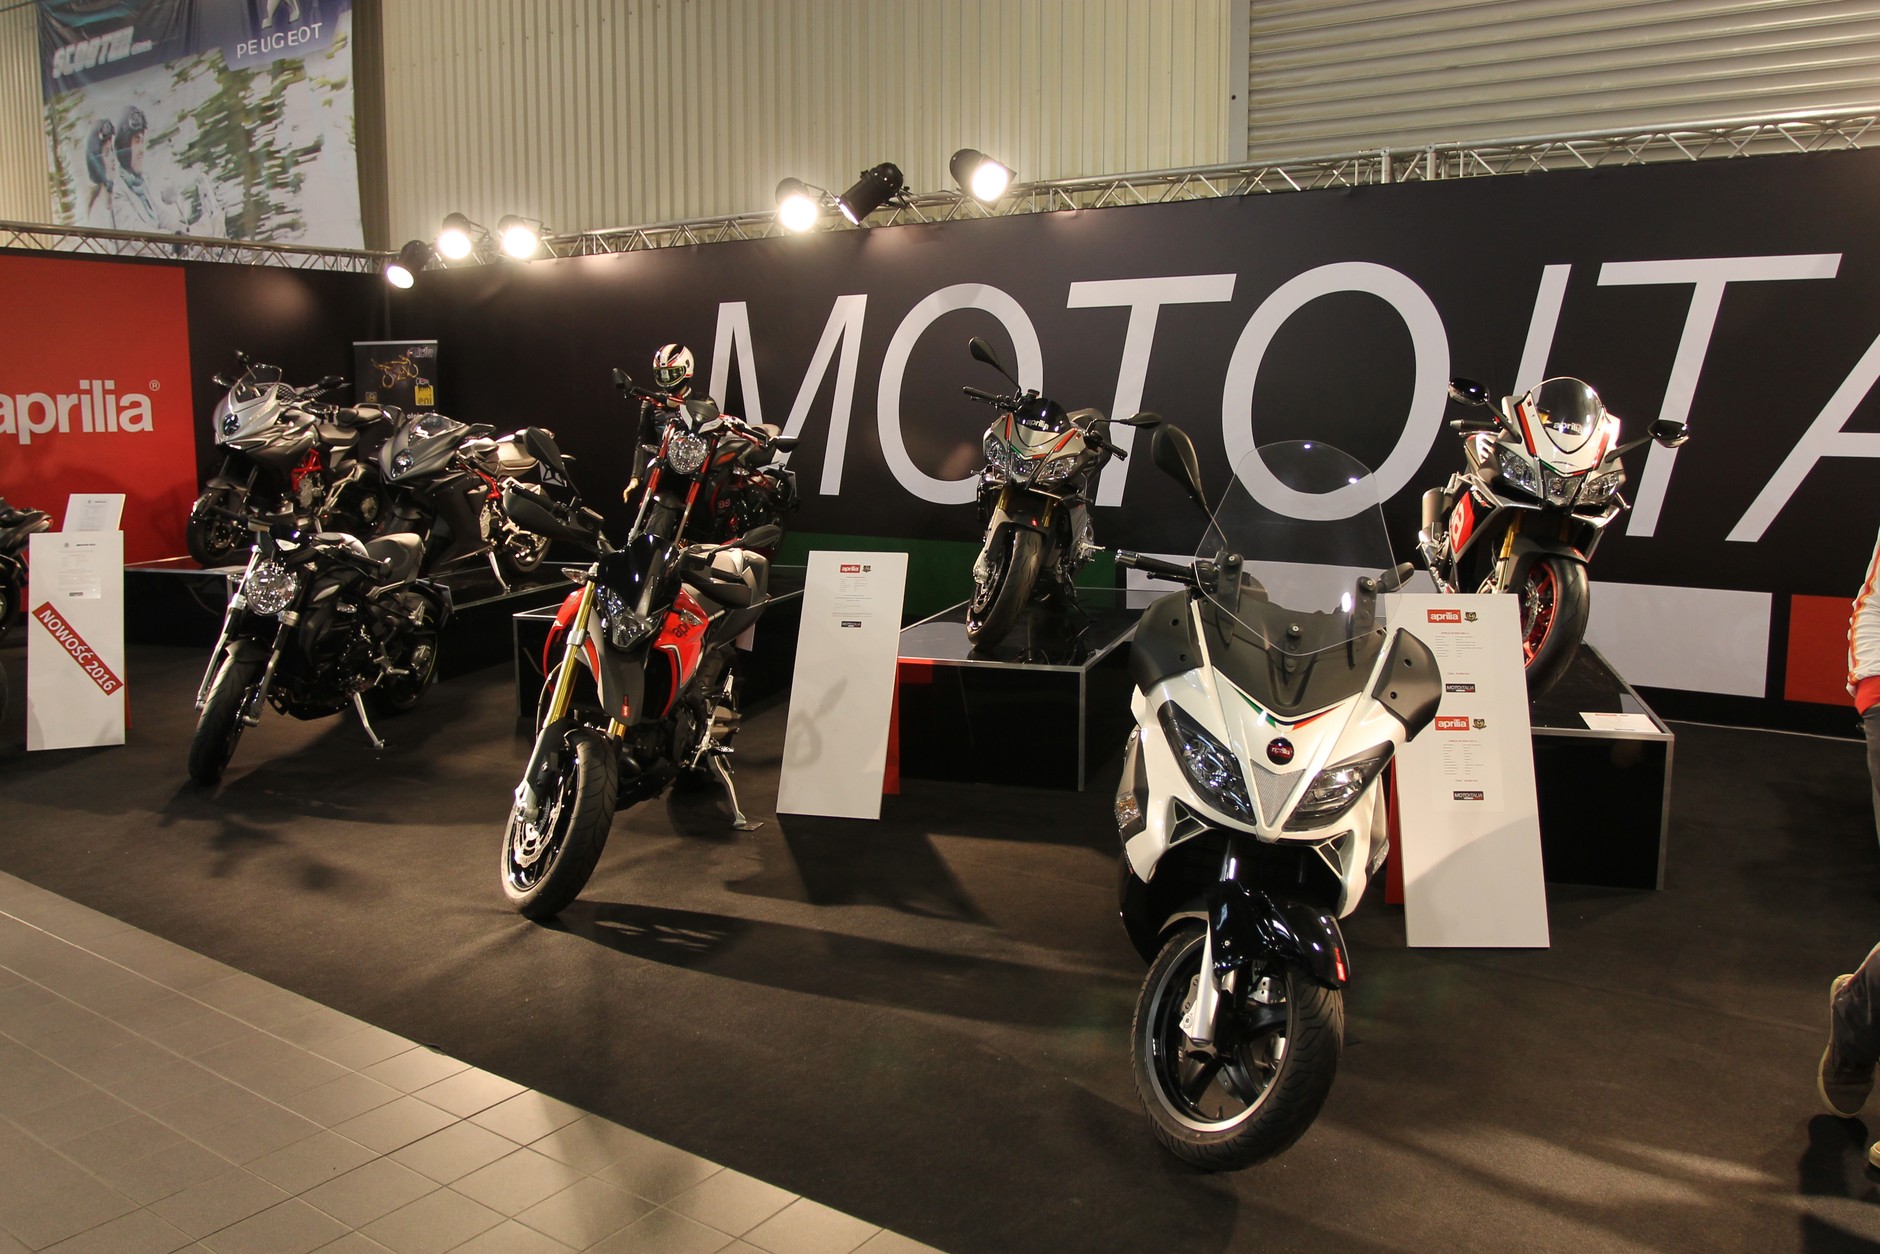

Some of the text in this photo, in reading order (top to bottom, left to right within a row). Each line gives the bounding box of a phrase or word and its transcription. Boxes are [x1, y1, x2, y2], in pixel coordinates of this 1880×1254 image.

[236, 22, 322, 59] PEUGEOT
[417, 394, 432, 405] eni
[0, 379, 154, 445] aprilia
[1430, 611, 1459, 622] aprilia
[39, 609, 94, 664] NOWOŚĆ
[84, 660, 117, 691] 2016
[1438, 719, 1467, 729] aprilia
